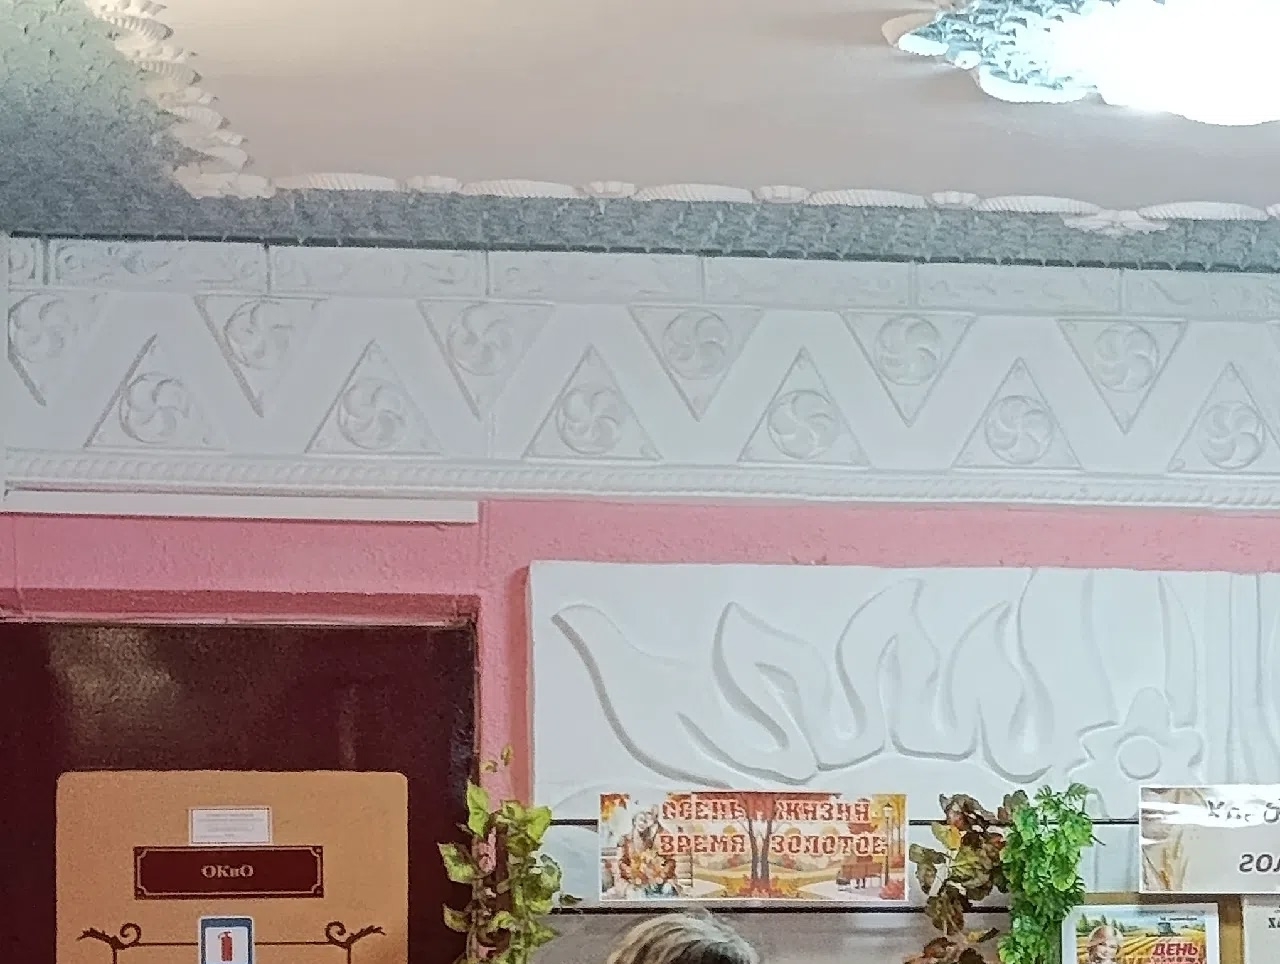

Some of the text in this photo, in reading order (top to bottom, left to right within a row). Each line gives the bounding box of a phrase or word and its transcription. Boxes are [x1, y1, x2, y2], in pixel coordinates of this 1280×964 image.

[662, 800, 871, 821] ОСЕНЬ ЖИЗНИ
[659, 833, 888, 855] ВРЕМЯ ЗОЛОТОЕ
[200, 864, 254, 878] ОКиО
[1152, 942, 1198, 956] ДЕНЬ
